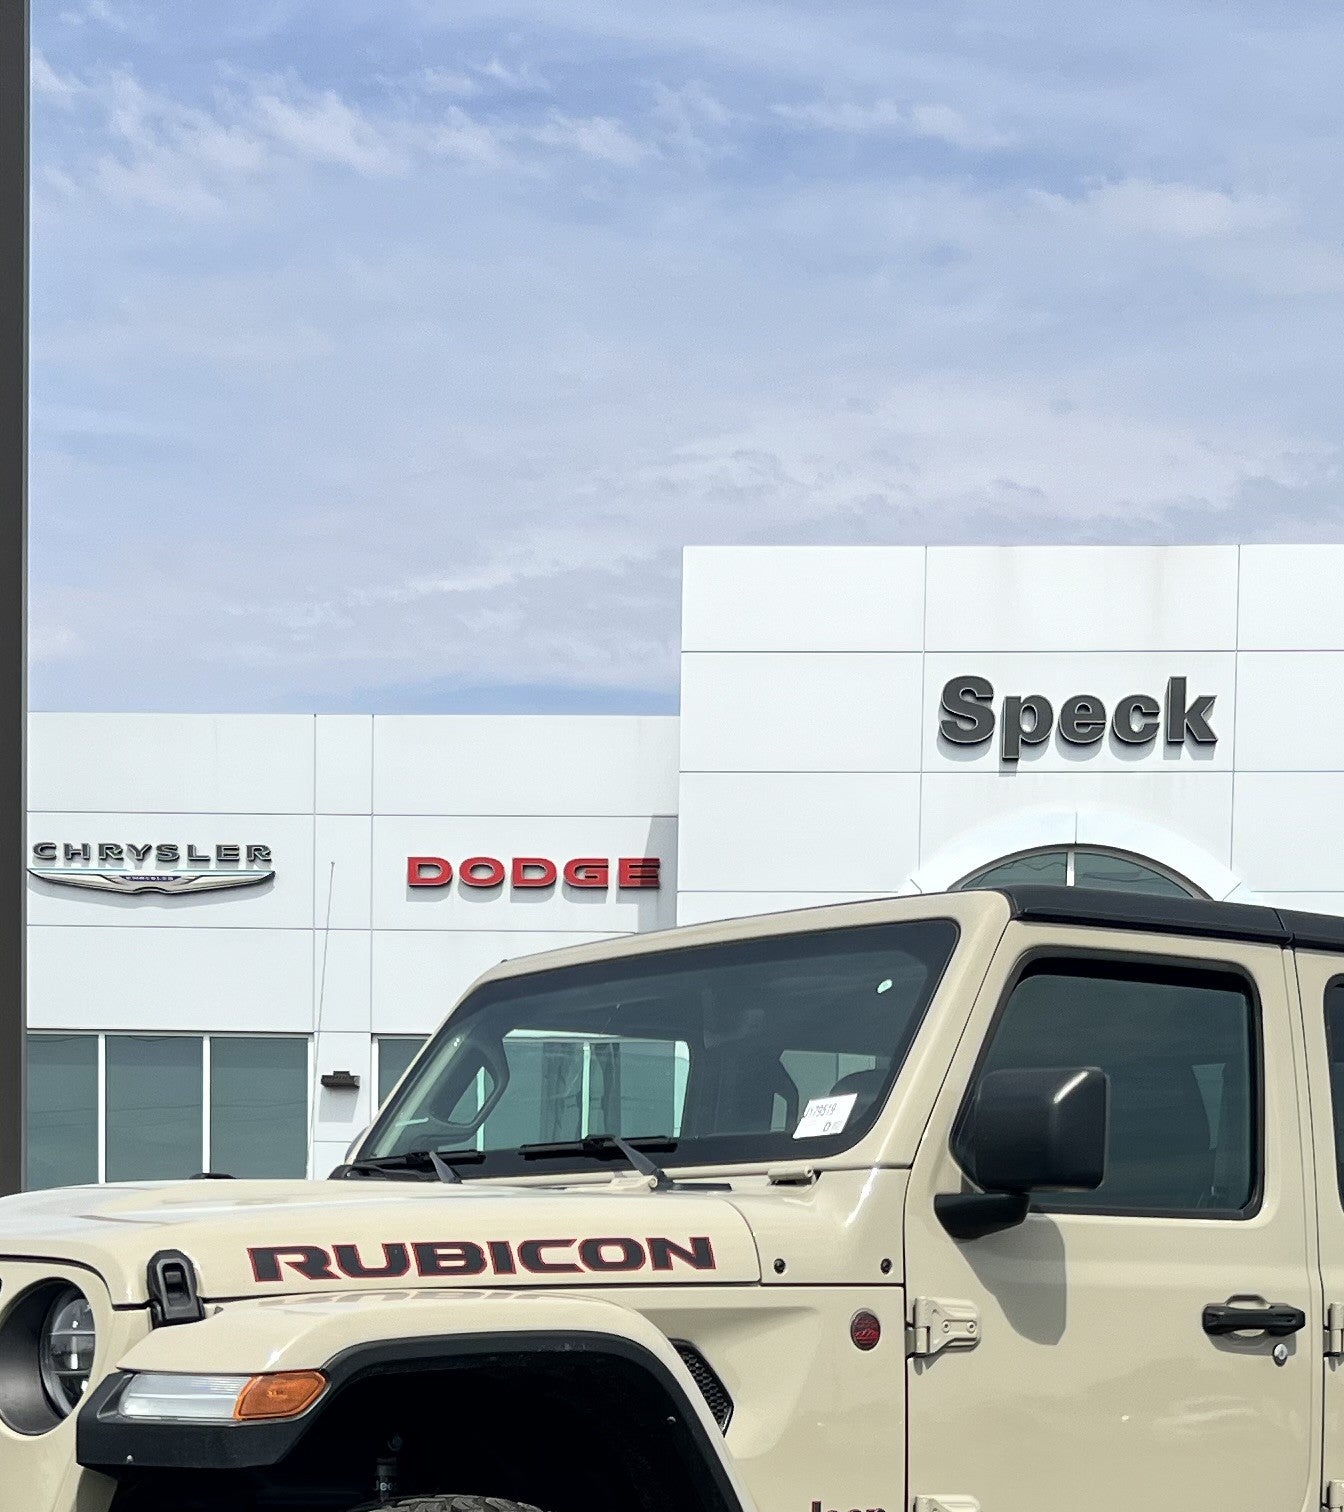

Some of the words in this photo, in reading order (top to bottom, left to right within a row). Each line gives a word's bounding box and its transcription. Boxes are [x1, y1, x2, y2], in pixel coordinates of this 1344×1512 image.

[940, 675, 1218, 761] Speck
[32, 841, 273, 862] CHRYSLER
[407, 856, 660, 889] DODGE
[246, 1236, 717, 1283] RUBICON
